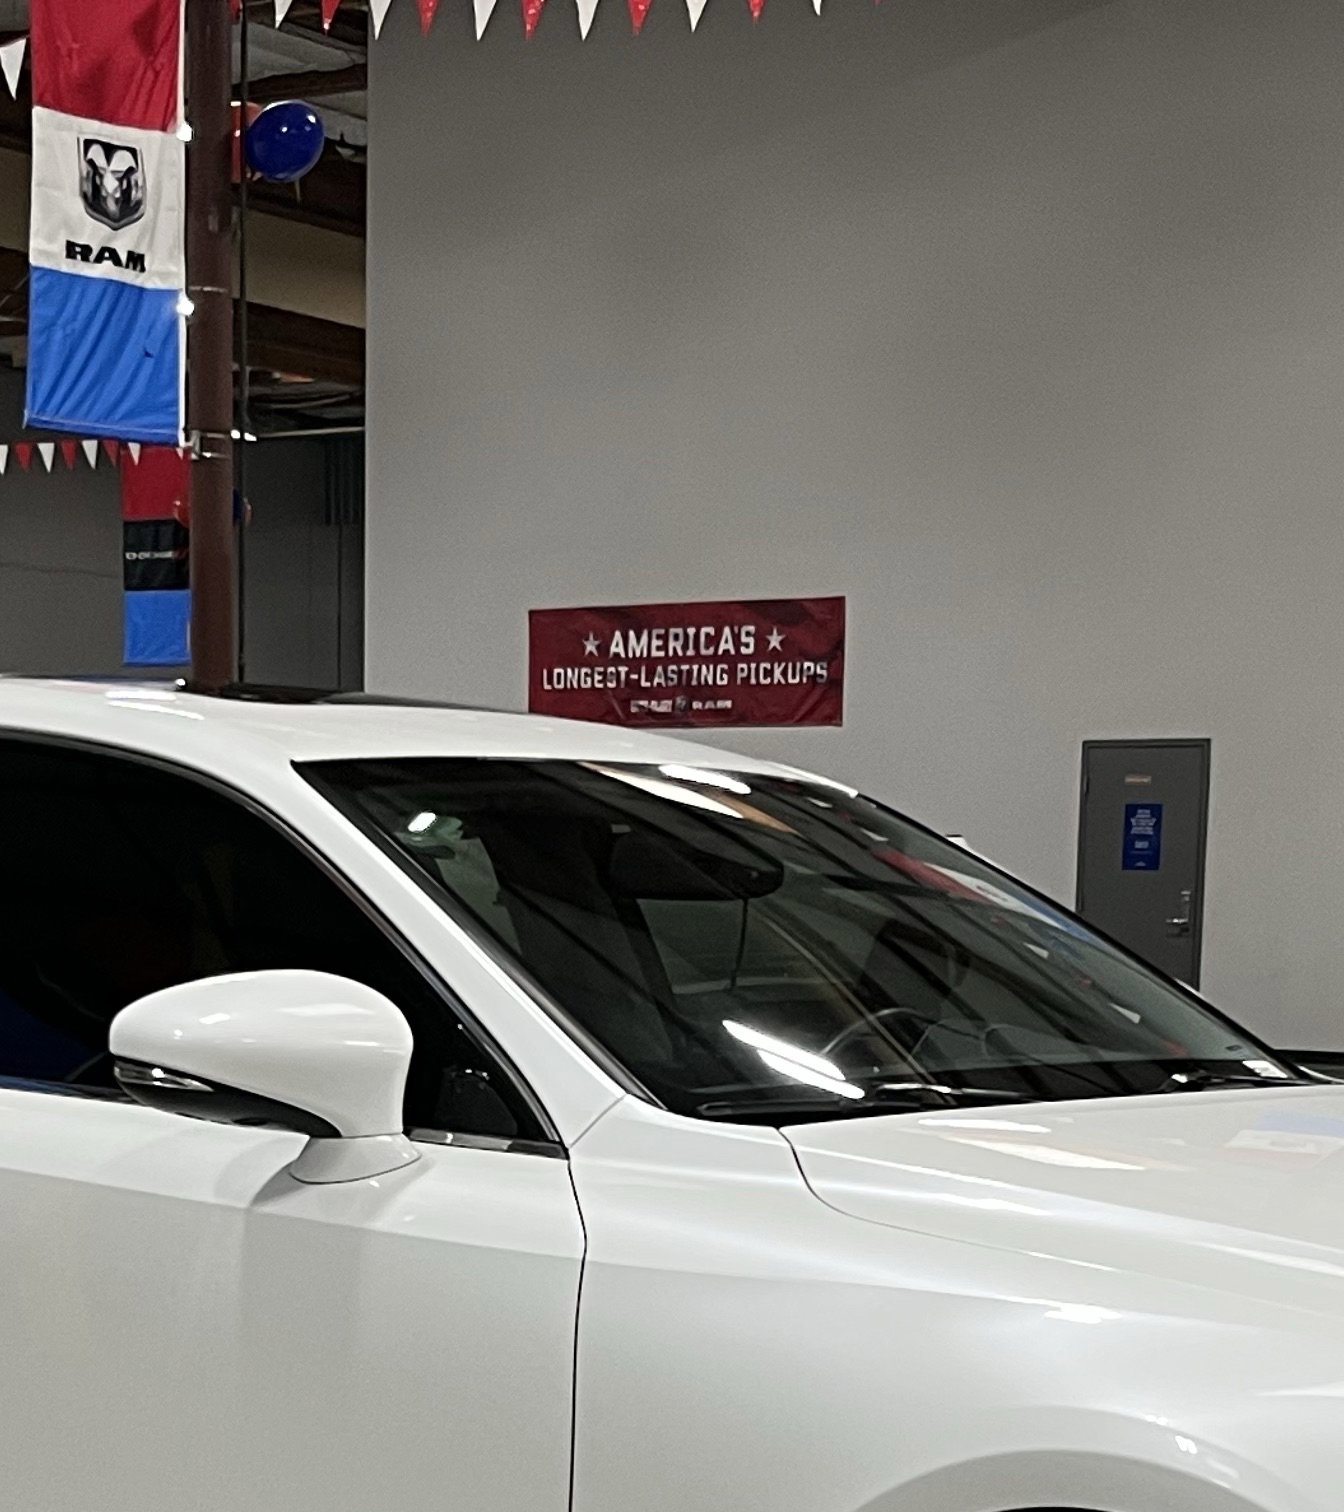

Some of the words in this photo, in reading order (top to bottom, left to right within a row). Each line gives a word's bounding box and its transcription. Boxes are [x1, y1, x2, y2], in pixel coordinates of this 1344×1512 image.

[65, 239, 146, 273] RAM
[608, 625, 756, 659] AMERICA'S
[542, 664, 729, 691] LONGEST-LASTING
[736, 661, 828, 686] PICKUPS
